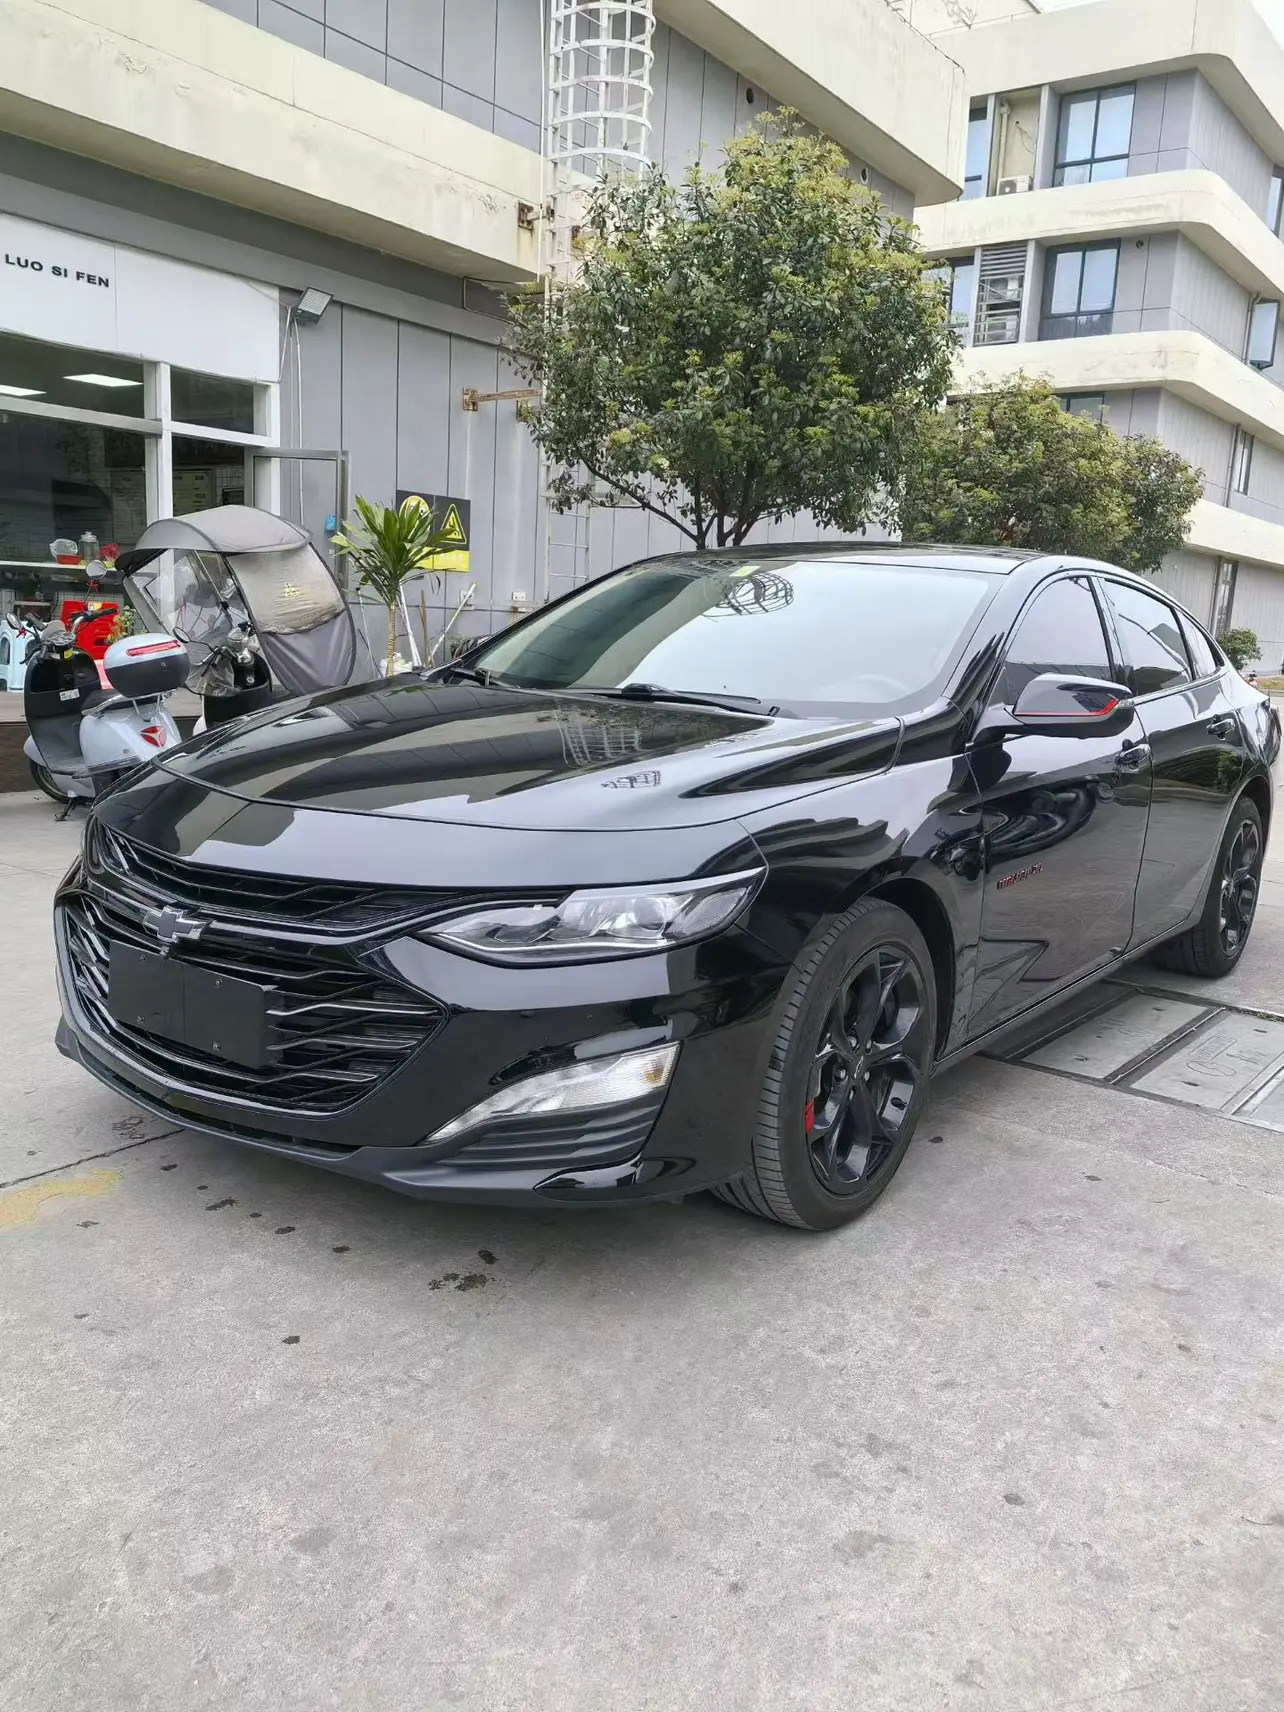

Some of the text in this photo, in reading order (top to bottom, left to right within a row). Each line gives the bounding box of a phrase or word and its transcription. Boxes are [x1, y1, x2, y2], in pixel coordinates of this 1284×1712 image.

[5, 254, 109, 288] LUO SI FEN
